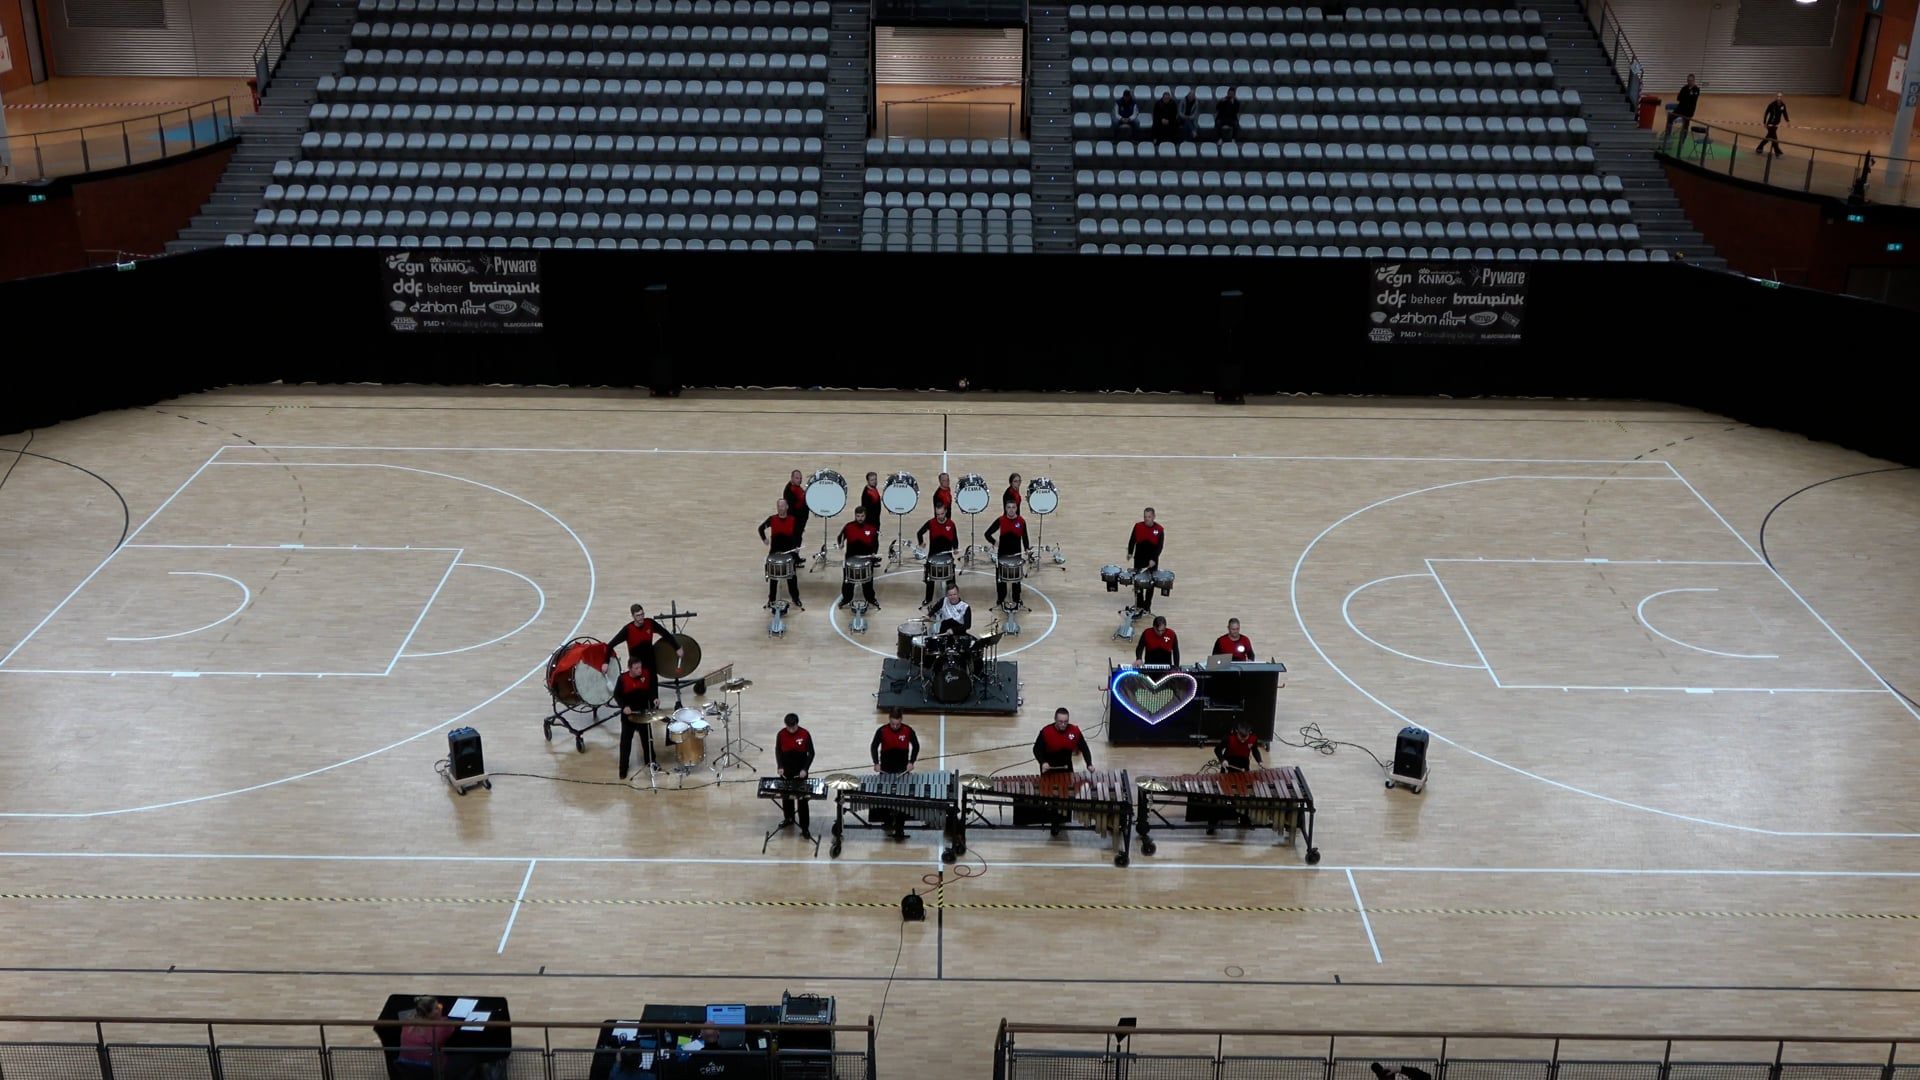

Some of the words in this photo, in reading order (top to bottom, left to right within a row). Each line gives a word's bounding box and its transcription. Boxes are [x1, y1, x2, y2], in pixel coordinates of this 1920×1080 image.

[397, 263, 424, 276] cgn
[430, 262, 466, 273] KNMO
[494, 256, 537, 276] Pyware
[1386, 273, 1412, 287] cgn
[1418, 274, 1454, 284] KNMO
[1482, 267, 1526, 287] Pyware
[392, 278, 423, 297] ddf
[427, 283, 464, 293] beheer
[469, 281, 540, 295] brainpink
[1376, 289, 1407, 308] ddf
[1411, 293, 1447, 305] beheer
[1453, 292, 1525, 307] brainpink
[420, 301, 458, 314] zhbm
[1399, 311, 1438, 325] zhbm
